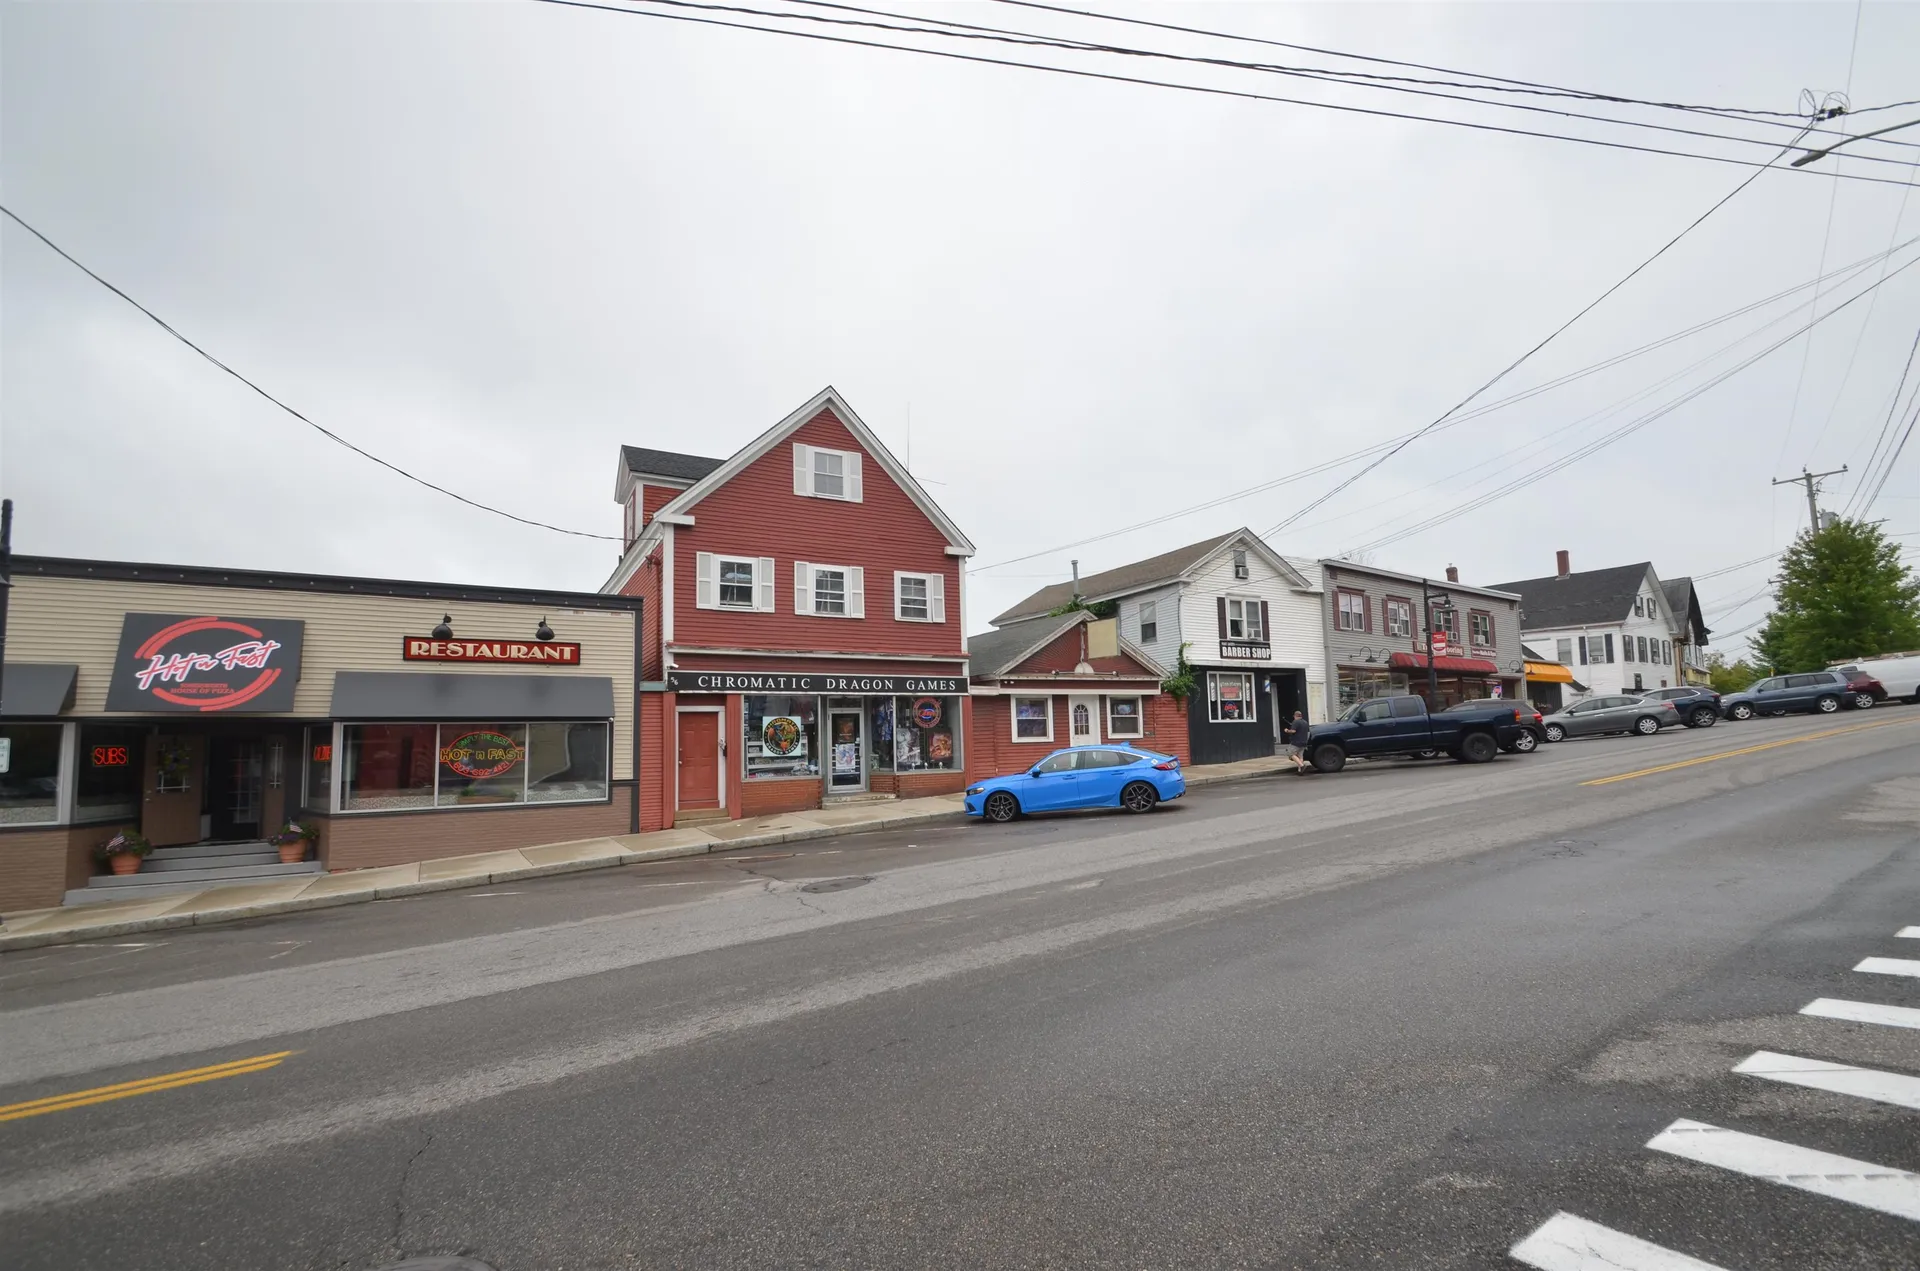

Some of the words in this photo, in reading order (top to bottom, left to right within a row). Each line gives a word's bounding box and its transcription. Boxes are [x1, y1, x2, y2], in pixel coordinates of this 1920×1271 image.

[410, 641, 576, 660] RESTAURANT
[1222, 646, 1250, 657] BARBER
[1252, 647, 1270, 658] SHOP
[135, 653, 206, 690] Hot
[215, 640, 282, 670] Fast
[698, 675, 811, 689] CHROMATIC
[826, 678, 894, 690] DRAGON
[906, 680, 956, 691] GAMES
[480, 733, 493, 741] THE
[493, 735, 510, 746] BEST
[94, 747, 128, 765] SUBS
[440, 748, 471, 760] HOT
[487, 748, 525, 760] FAST
